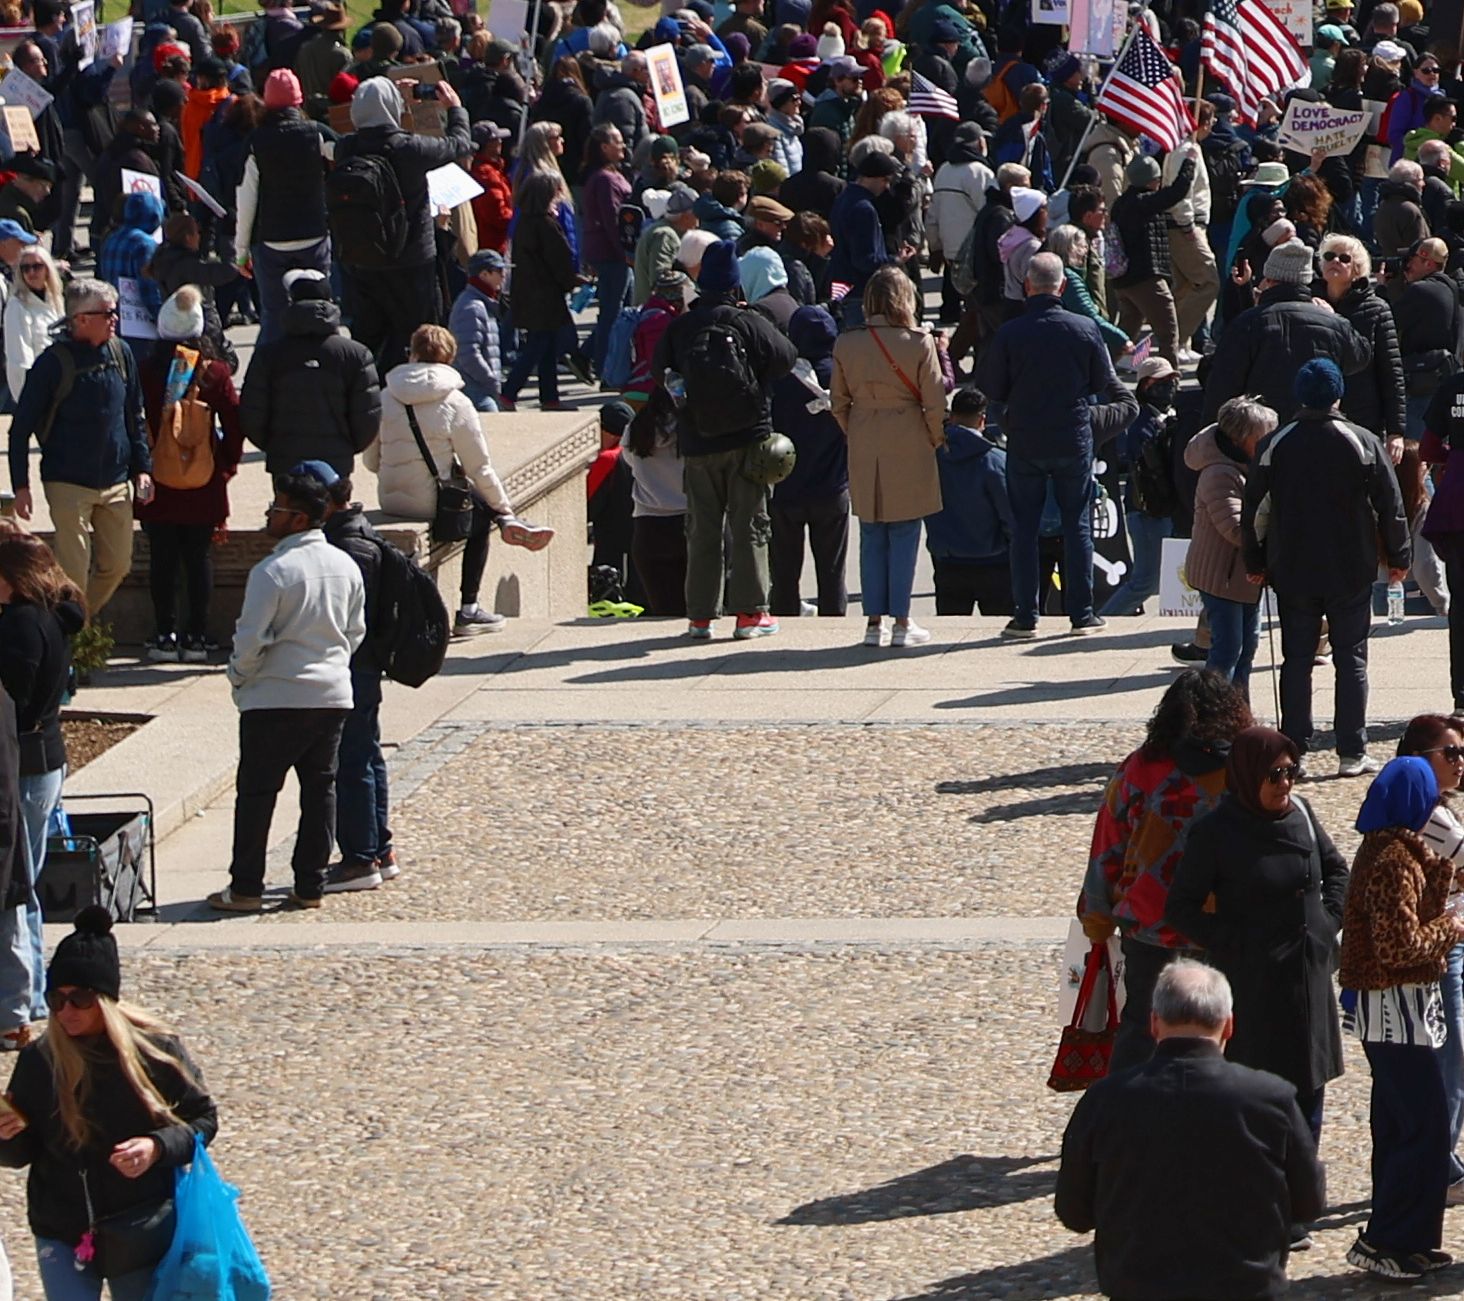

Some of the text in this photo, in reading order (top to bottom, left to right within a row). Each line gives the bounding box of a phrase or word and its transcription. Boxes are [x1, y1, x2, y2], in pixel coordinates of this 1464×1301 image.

[1293, 106, 1330, 119] LOVE
[1291, 112, 1365, 132] DEMOCRACY
[1315, 129, 1347, 146] HATE
